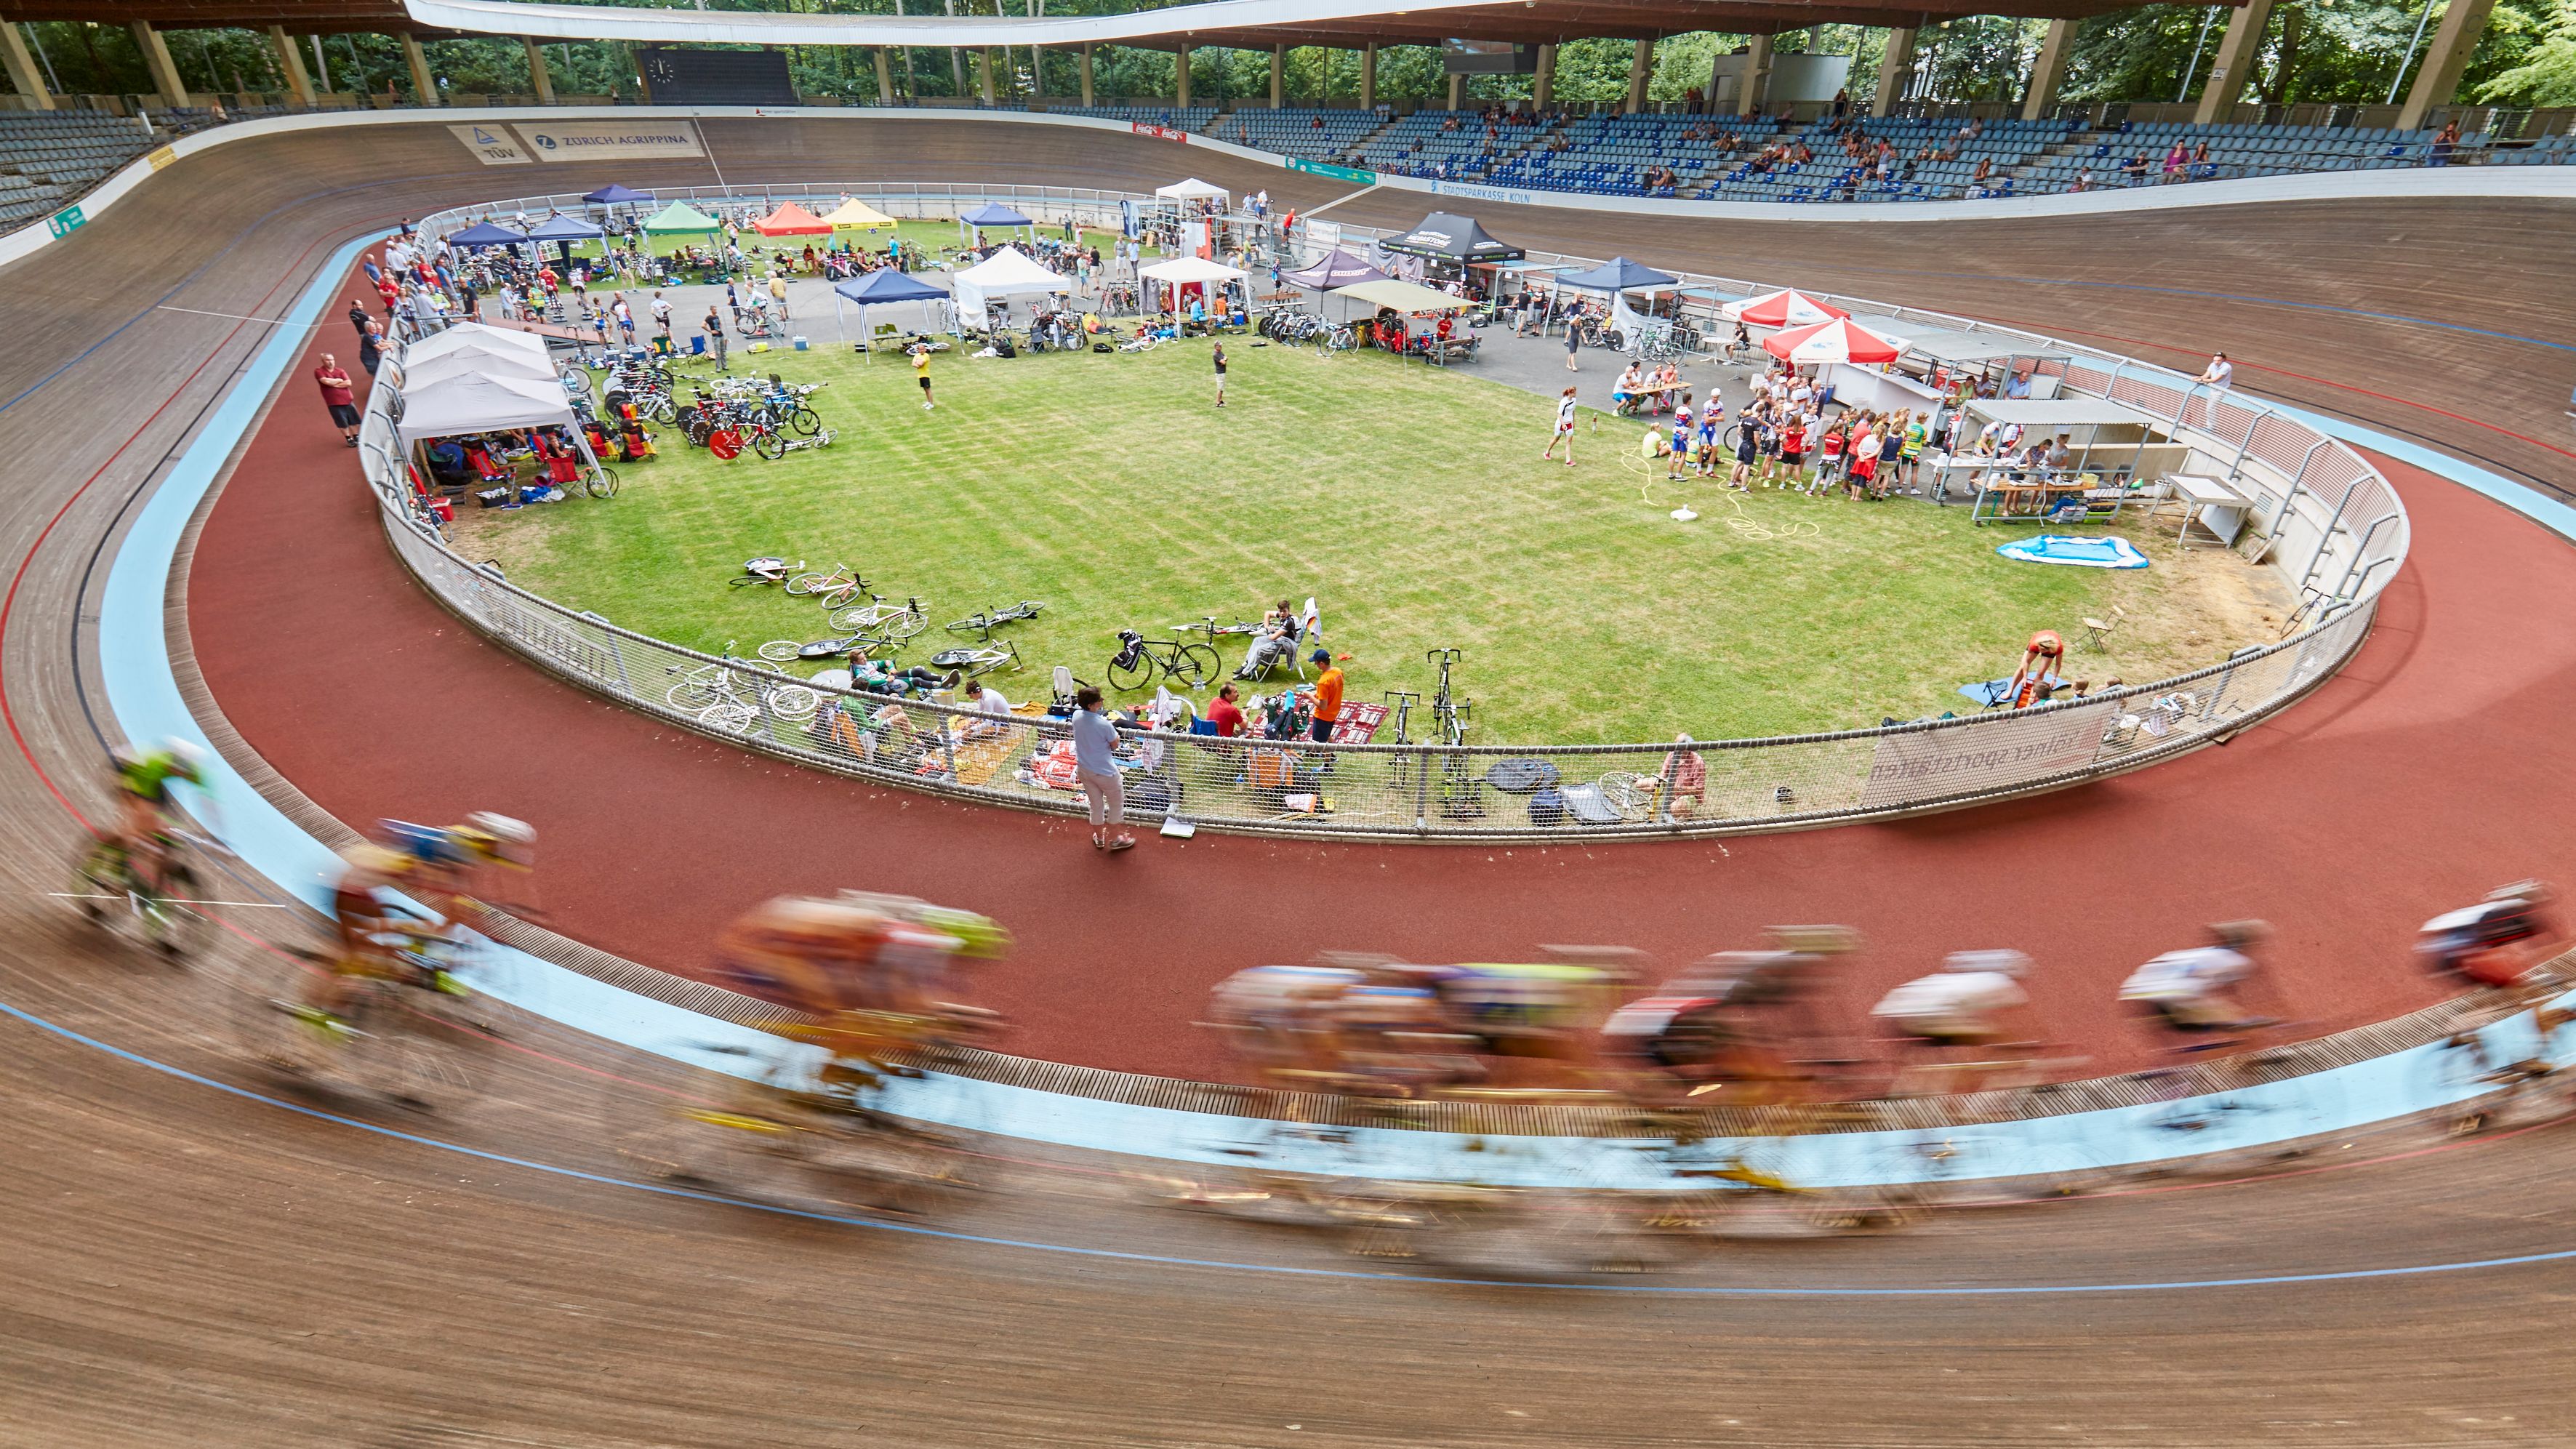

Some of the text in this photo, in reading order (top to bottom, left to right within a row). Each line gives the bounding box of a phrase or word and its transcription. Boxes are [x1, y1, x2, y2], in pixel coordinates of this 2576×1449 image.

[619, 135, 689, 145] AGRIPPINA
[483, 147, 515, 158] TÜV
[1443, 185, 1505, 201] STADTSPARKASSE
